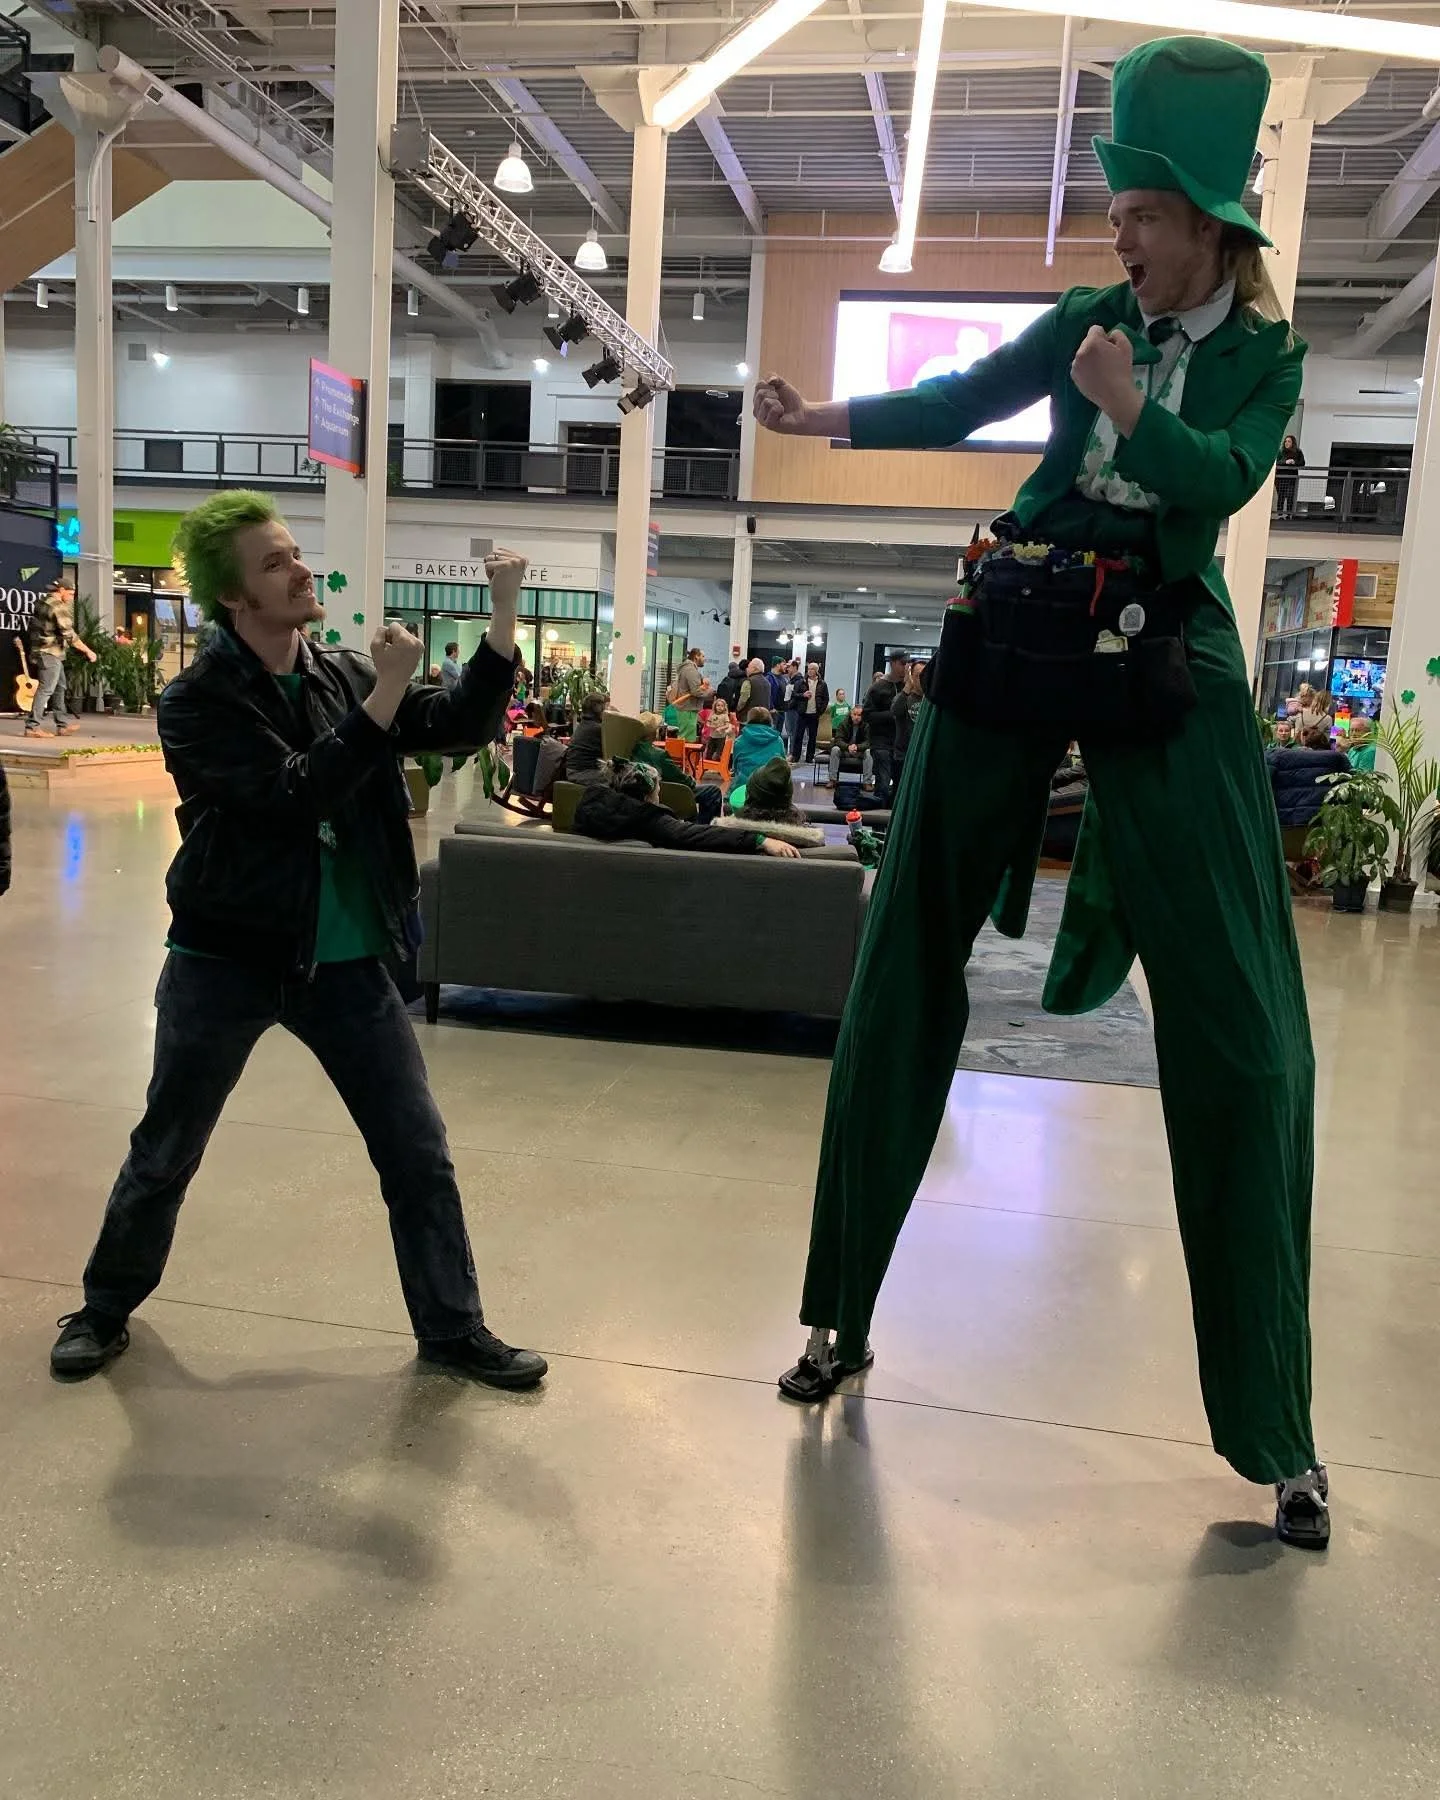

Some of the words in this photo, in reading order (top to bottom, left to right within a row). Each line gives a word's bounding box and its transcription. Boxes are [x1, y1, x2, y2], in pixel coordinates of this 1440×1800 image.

[321, 398, 332, 413] The
[333, 403, 360, 426] Exchange
[320, 416, 349, 437] Aquarium
[415, 563, 479, 577] BAKERY
